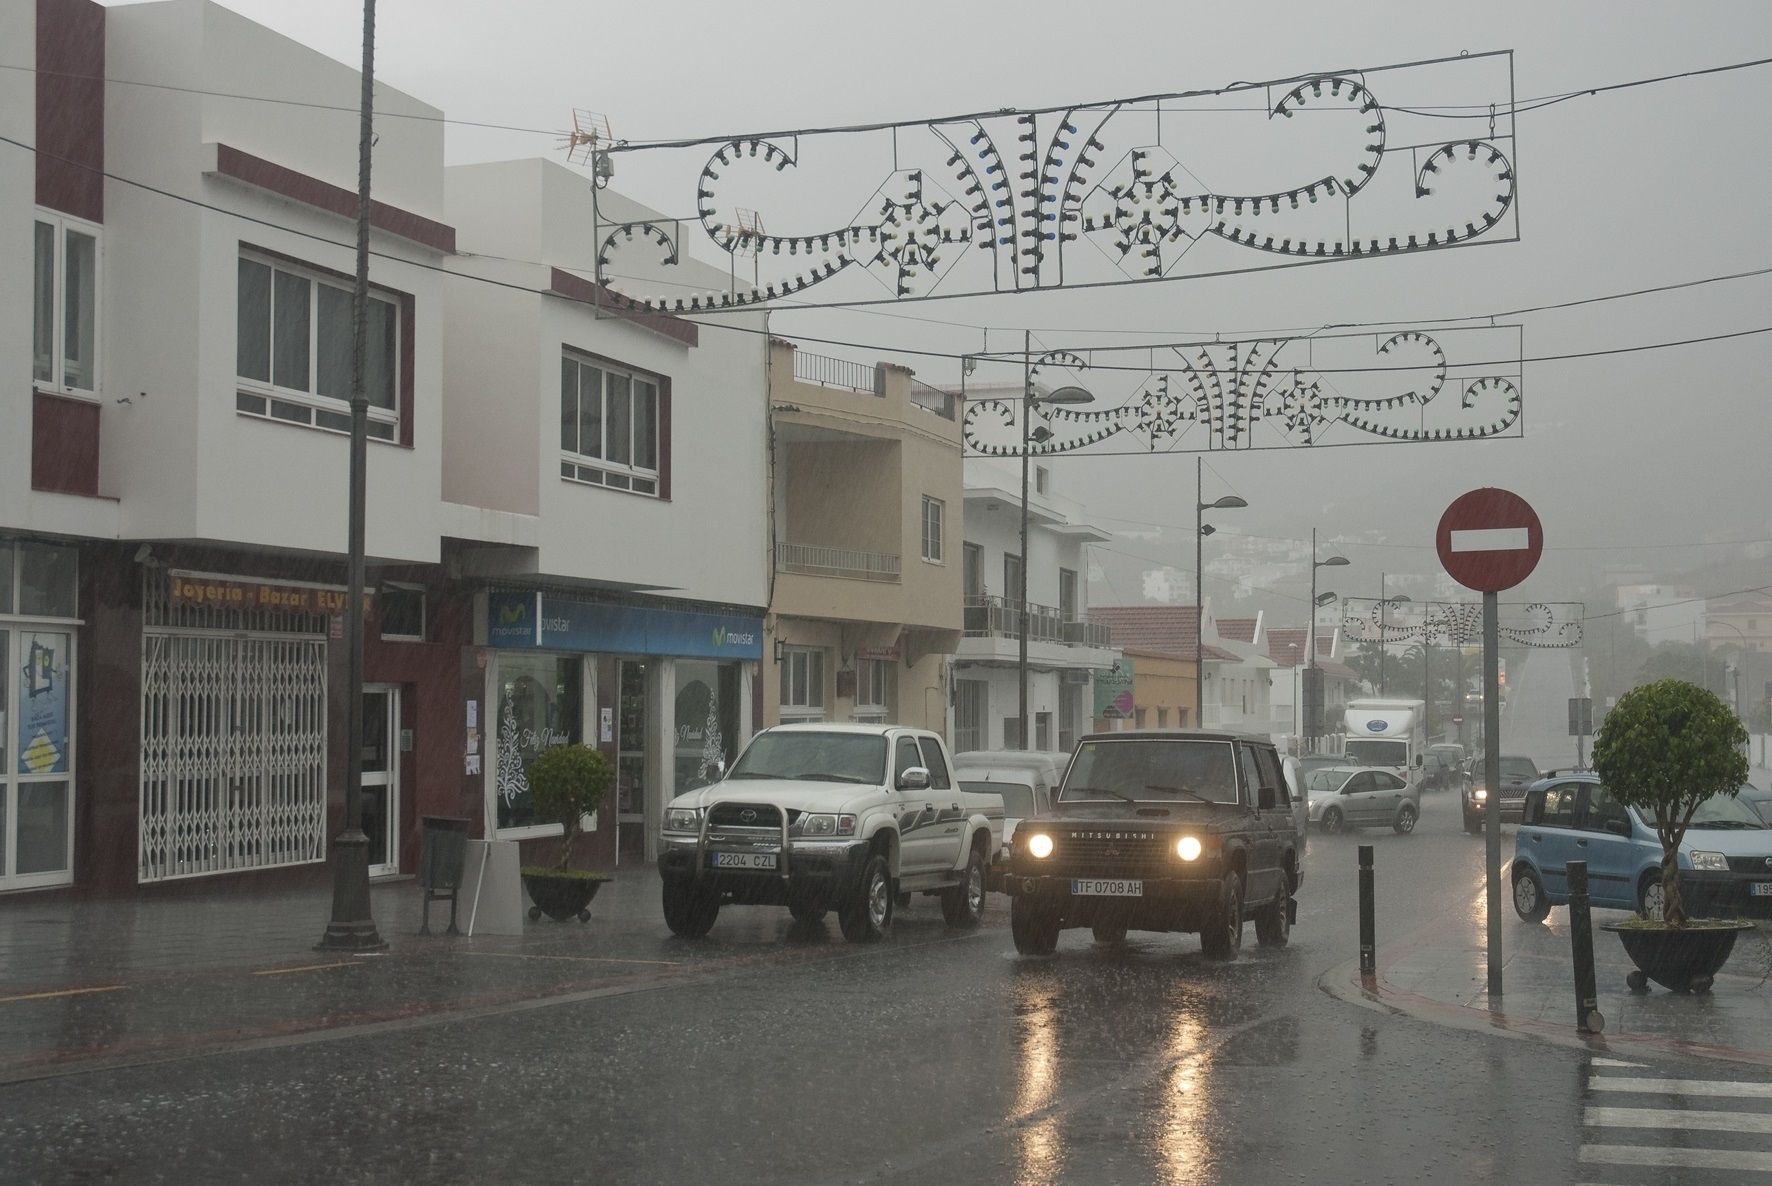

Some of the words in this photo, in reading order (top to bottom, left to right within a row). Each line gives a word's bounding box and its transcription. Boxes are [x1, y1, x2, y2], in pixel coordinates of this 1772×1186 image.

[259, 586, 306, 606] Bazar
[541, 616, 570, 632] ovistar
[492, 627, 532, 636] movistar
[726, 632, 754, 645] movistar
[1071, 832, 1154, 840] MITSUBISHI
[719, 854, 747, 866] 2204
[753, 855, 775, 867] CZL
[1078, 881, 1093, 893] TF
[1095, 881, 1124, 894] 0708
[1126, 882, 1142, 894] AH
